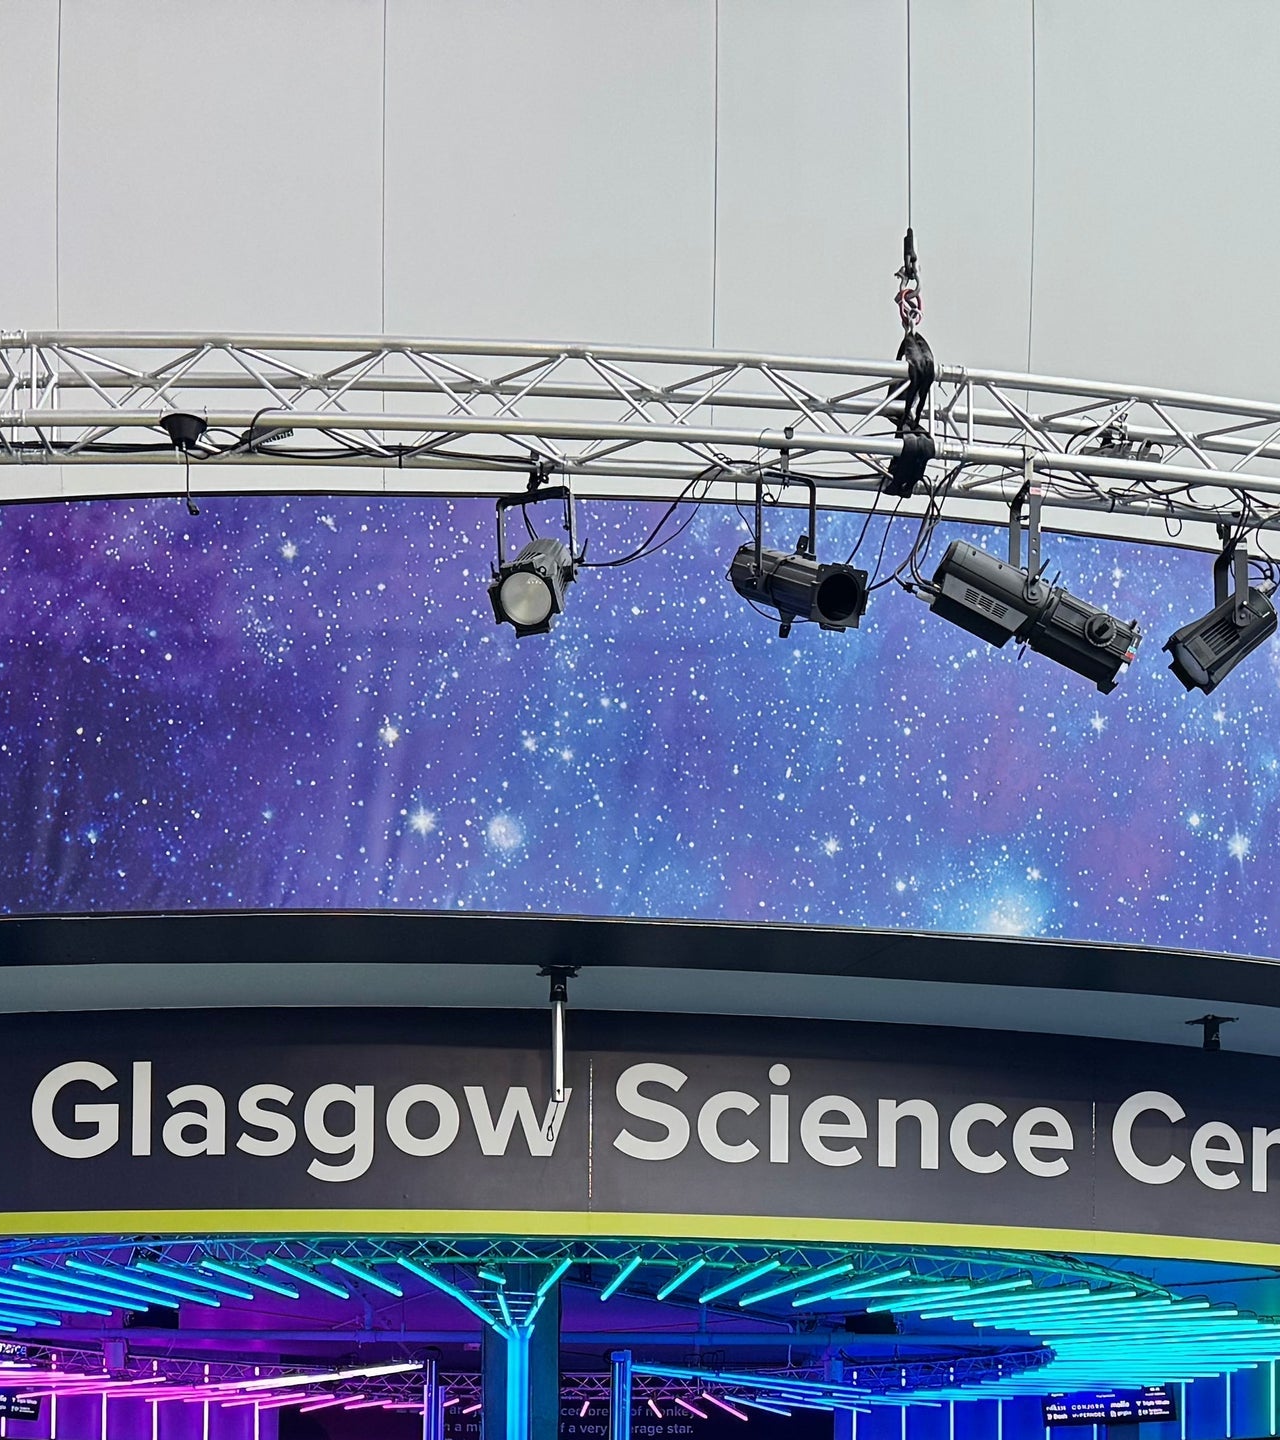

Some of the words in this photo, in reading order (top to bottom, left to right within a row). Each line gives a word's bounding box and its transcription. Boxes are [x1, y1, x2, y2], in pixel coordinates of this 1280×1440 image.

[31, 1061, 573, 1182] Glasgow
[612, 1062, 1074, 1178] Science
[580, 1424, 608, 1436] very
[667, 1424, 694, 1434] star.
